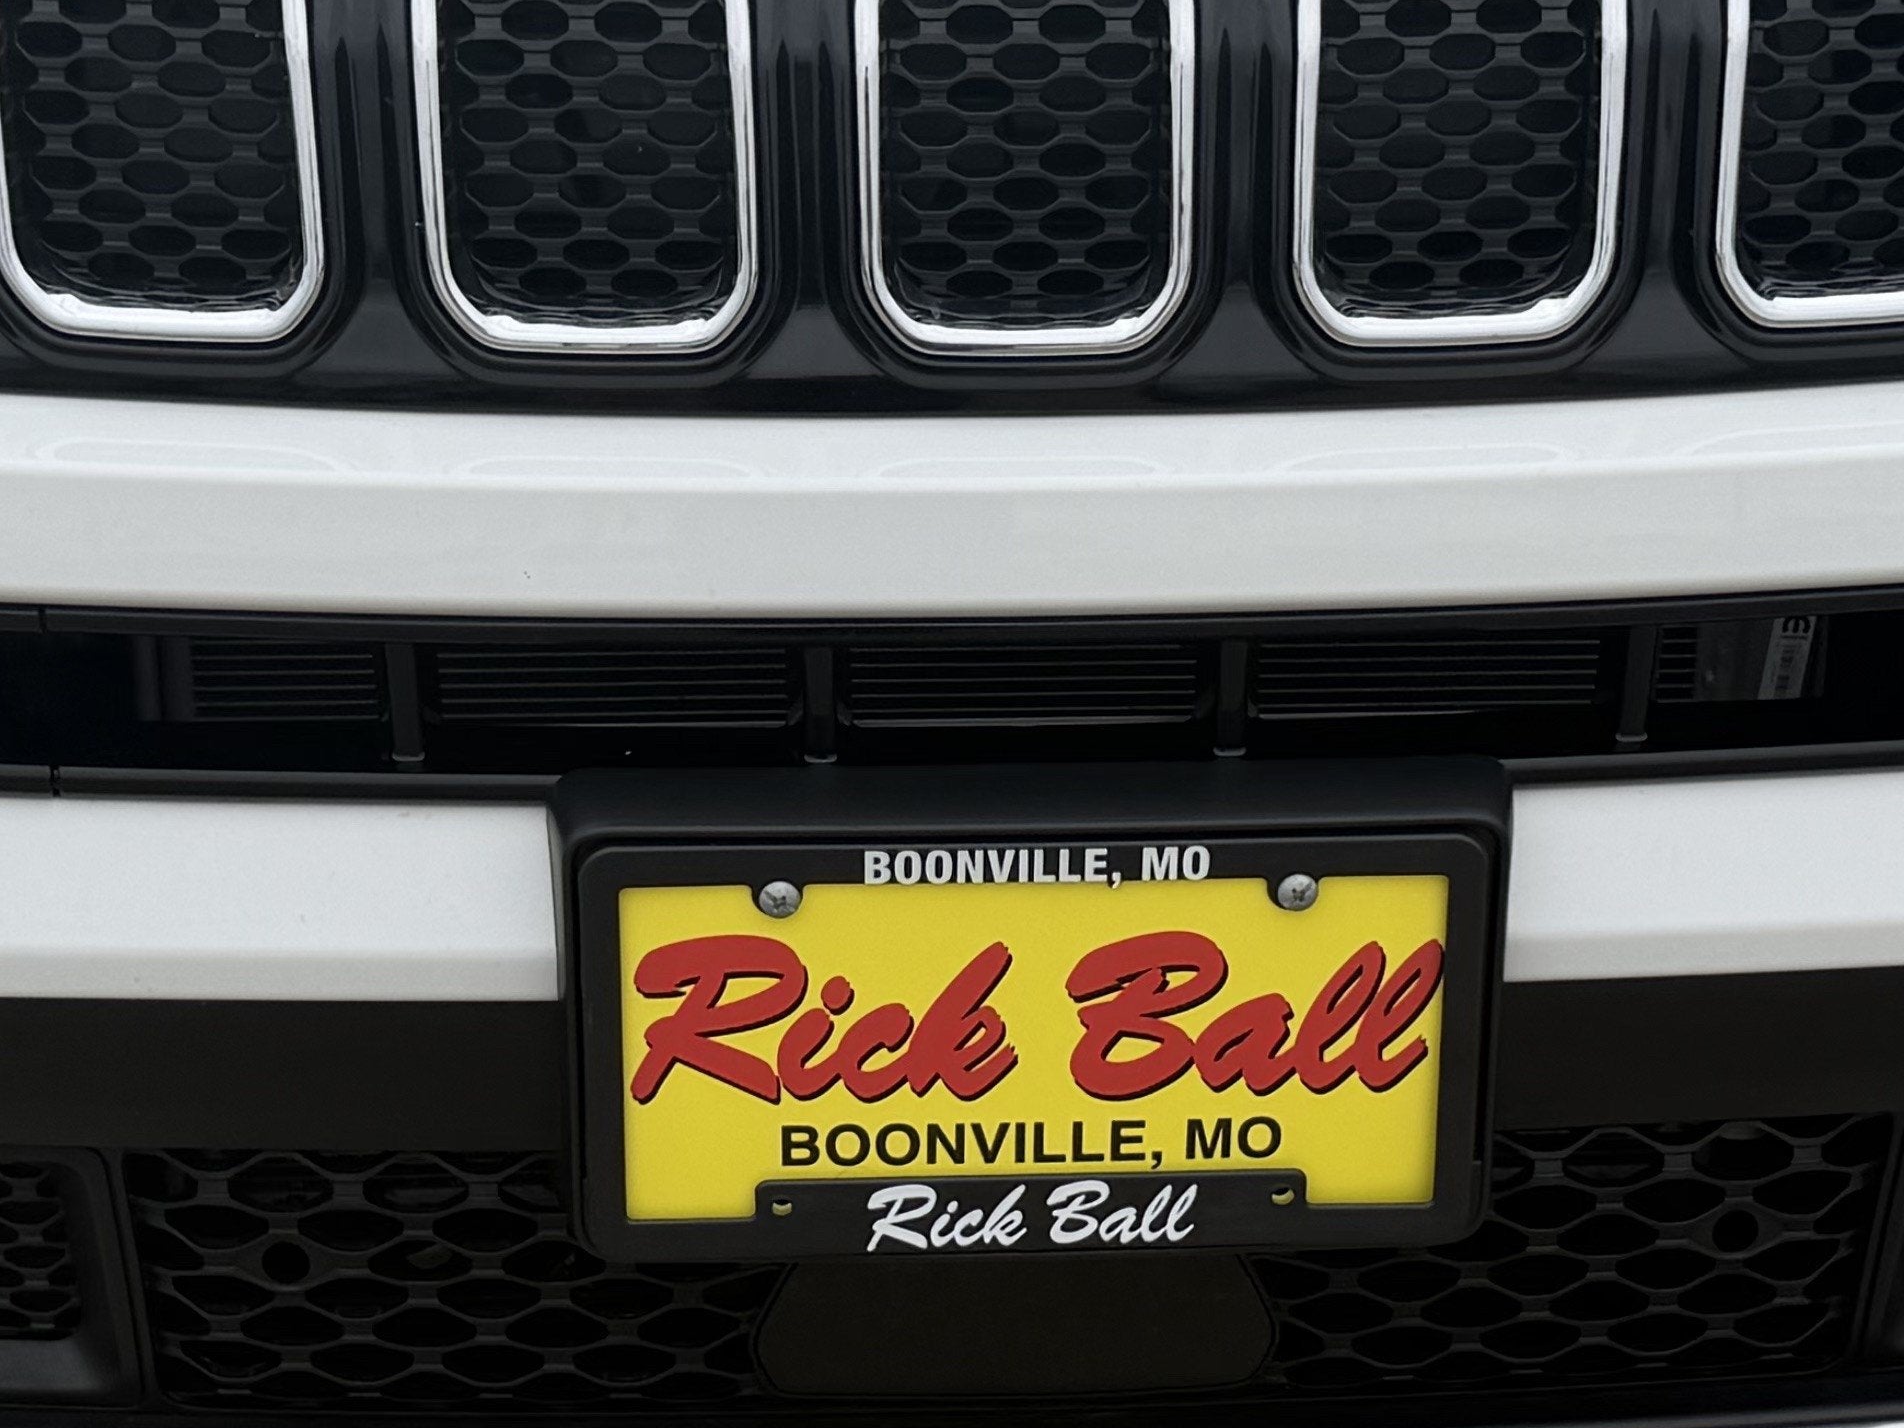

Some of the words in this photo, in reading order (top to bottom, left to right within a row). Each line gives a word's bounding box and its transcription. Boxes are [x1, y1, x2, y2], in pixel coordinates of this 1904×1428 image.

[863, 848, 1121, 889] BOONVILLE,
[1141, 845, 1211, 882] MO
[629, 934, 1018, 1104] Rick
[1064, 930, 1445, 1101] Ball
[780, 1119, 1164, 1170] BOONVILLE,
[1185, 1116, 1284, 1161] MO
[865, 1183, 1029, 1252] Rick
[1046, 1182, 1197, 1245] Ball
